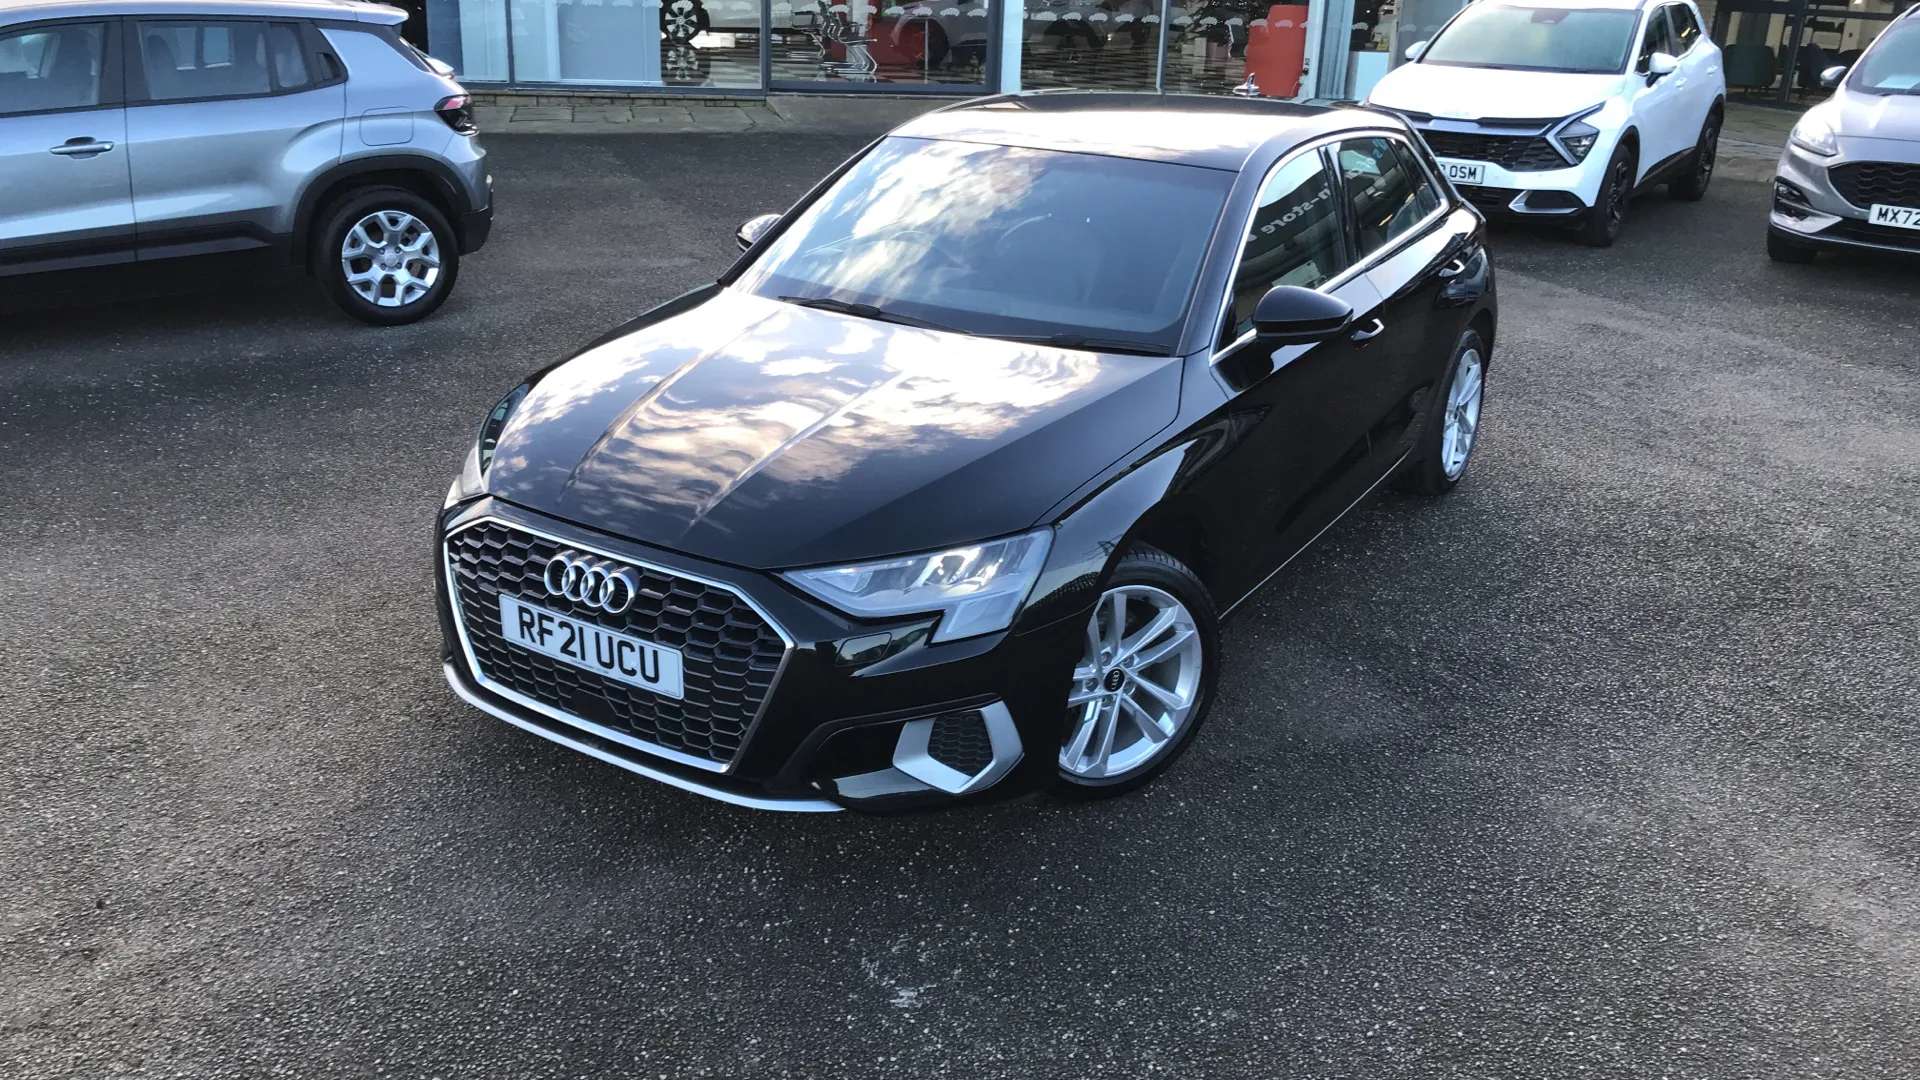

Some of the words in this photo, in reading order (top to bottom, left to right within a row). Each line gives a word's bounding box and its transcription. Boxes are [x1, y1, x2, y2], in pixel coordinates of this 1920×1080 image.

[1449, 165, 1477, 180] OSM
[1877, 206, 1920, 226] MX72
[517, 605, 586, 662] RF21
[594, 631, 660, 684] UCU
